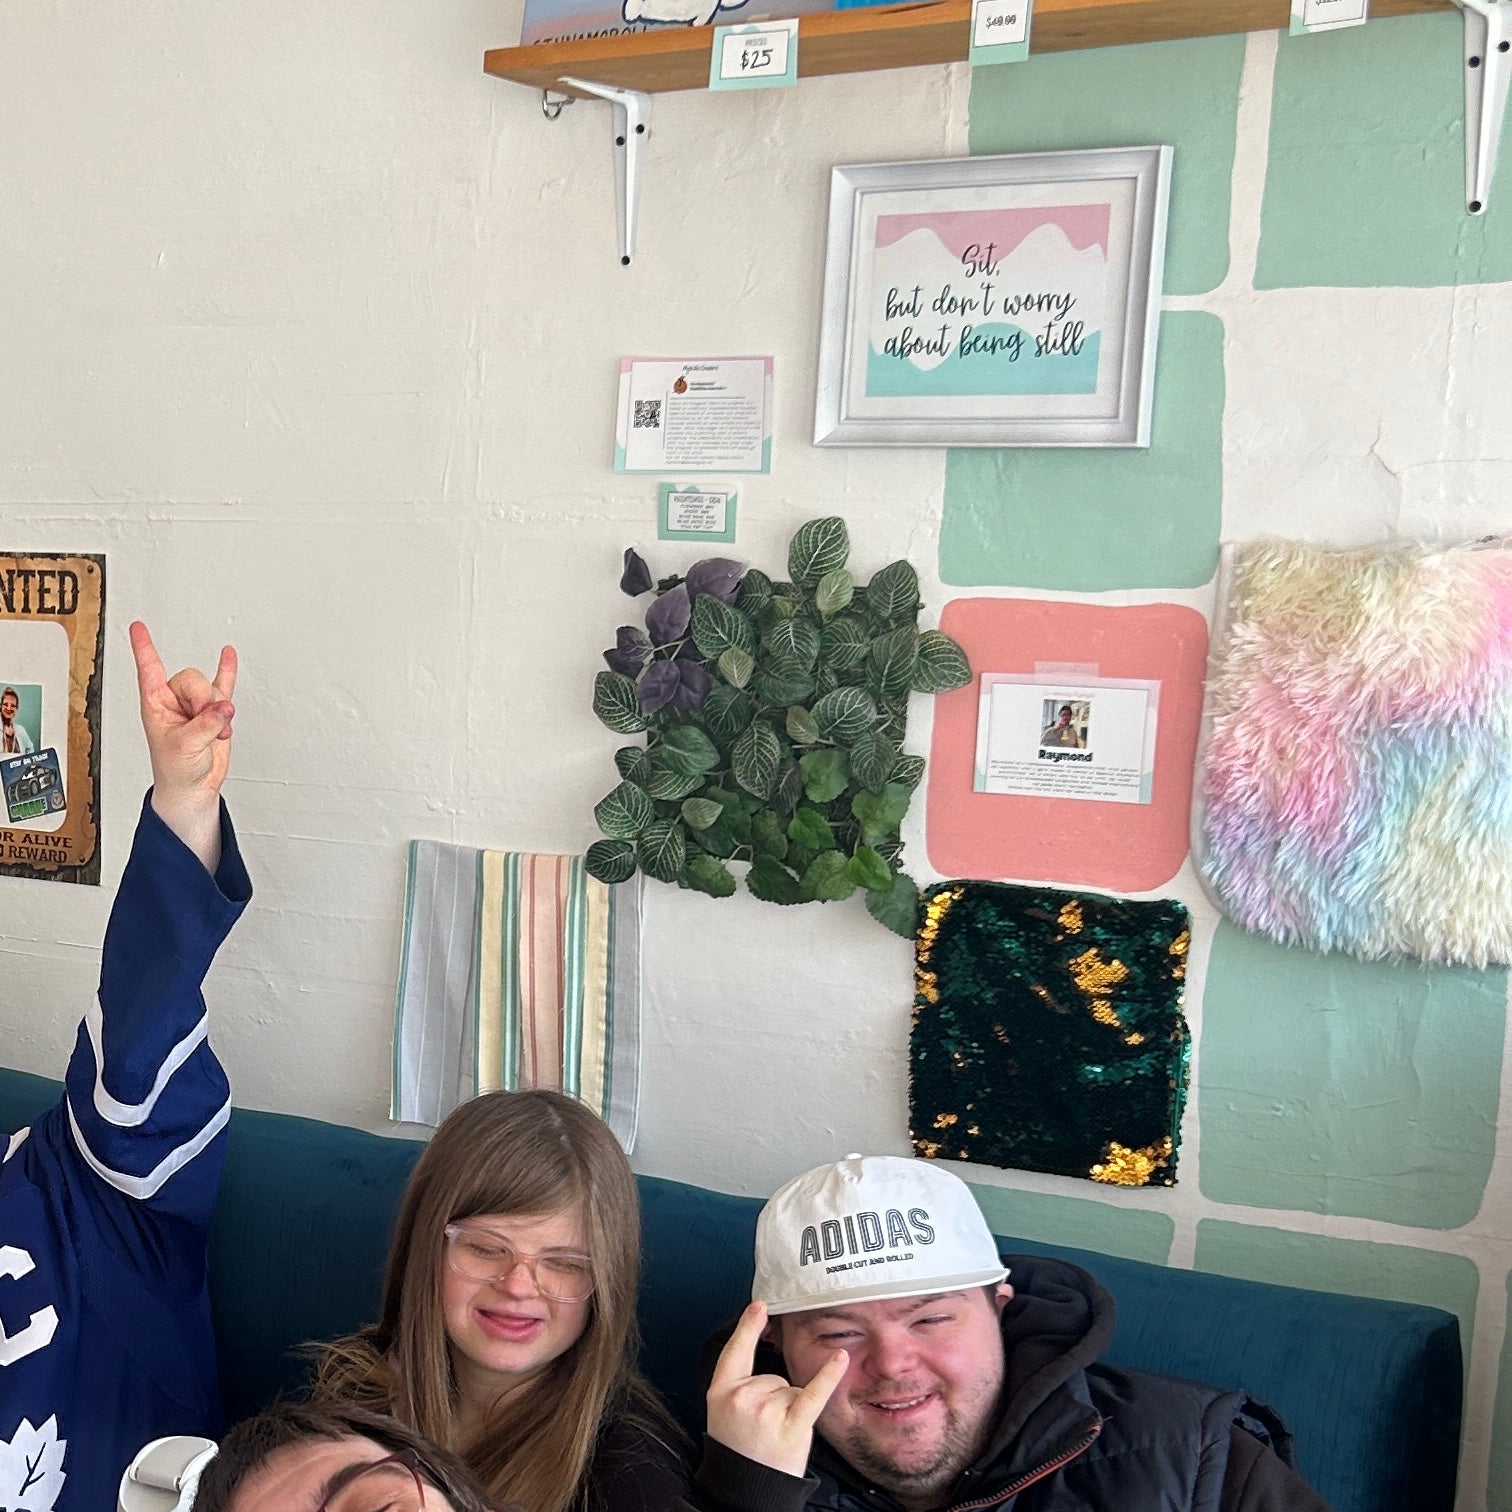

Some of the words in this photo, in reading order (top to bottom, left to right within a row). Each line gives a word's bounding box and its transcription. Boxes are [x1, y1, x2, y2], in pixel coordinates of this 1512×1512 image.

[740, 49, 773, 71] $25
[961, 242, 1001, 278] Sit,
[885, 285, 924, 321] but
[932, 282, 996, 316] don't
[1003, 291, 1078, 321] worry
[883, 324, 952, 360] about
[959, 325, 1026, 362] being
[1034, 321, 1087, 358] still
[1037, 749, 1093, 762] Raymond
[9, 845, 68, 863] REWARD
[21, 833, 73, 848] ALIVE
[799, 1208, 935, 1267] ADIDAS
